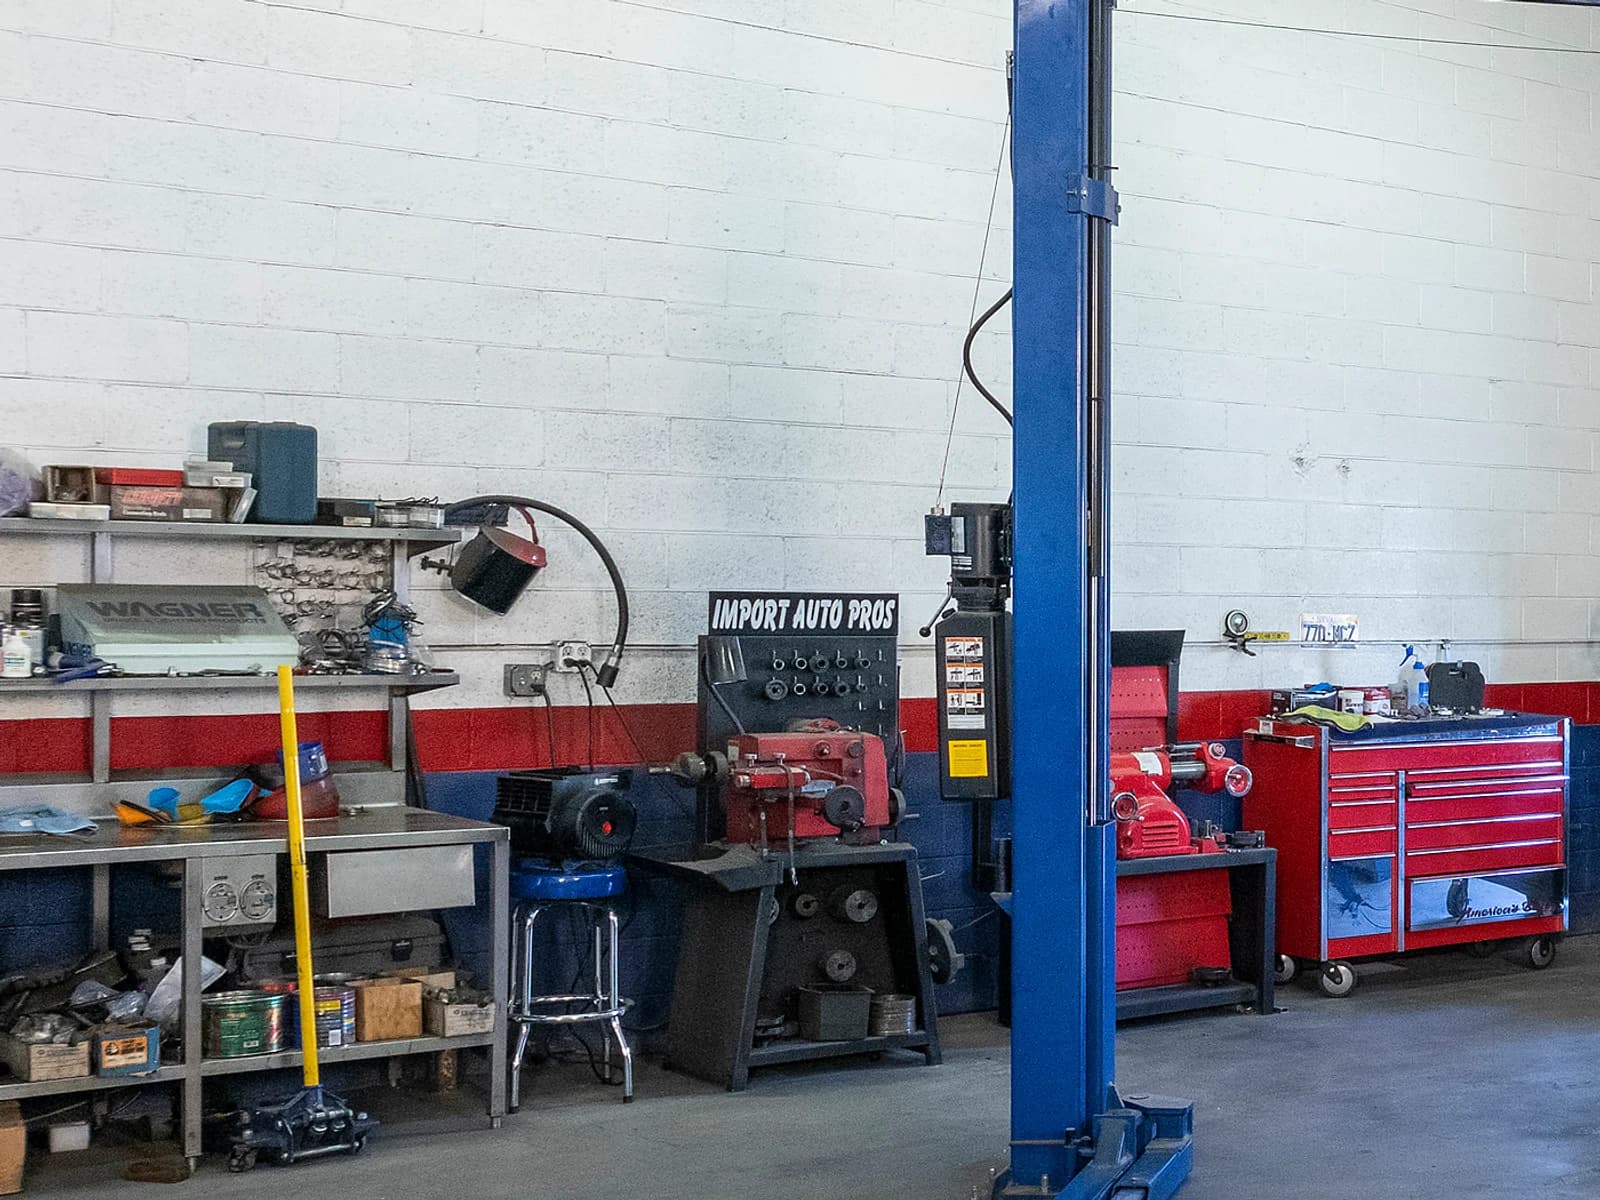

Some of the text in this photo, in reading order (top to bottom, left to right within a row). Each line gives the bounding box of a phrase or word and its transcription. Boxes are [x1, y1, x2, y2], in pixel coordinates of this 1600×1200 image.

[86, 601, 264, 617] WAGNER
[712, 599, 896, 632] IMPORT AUTO PROS
